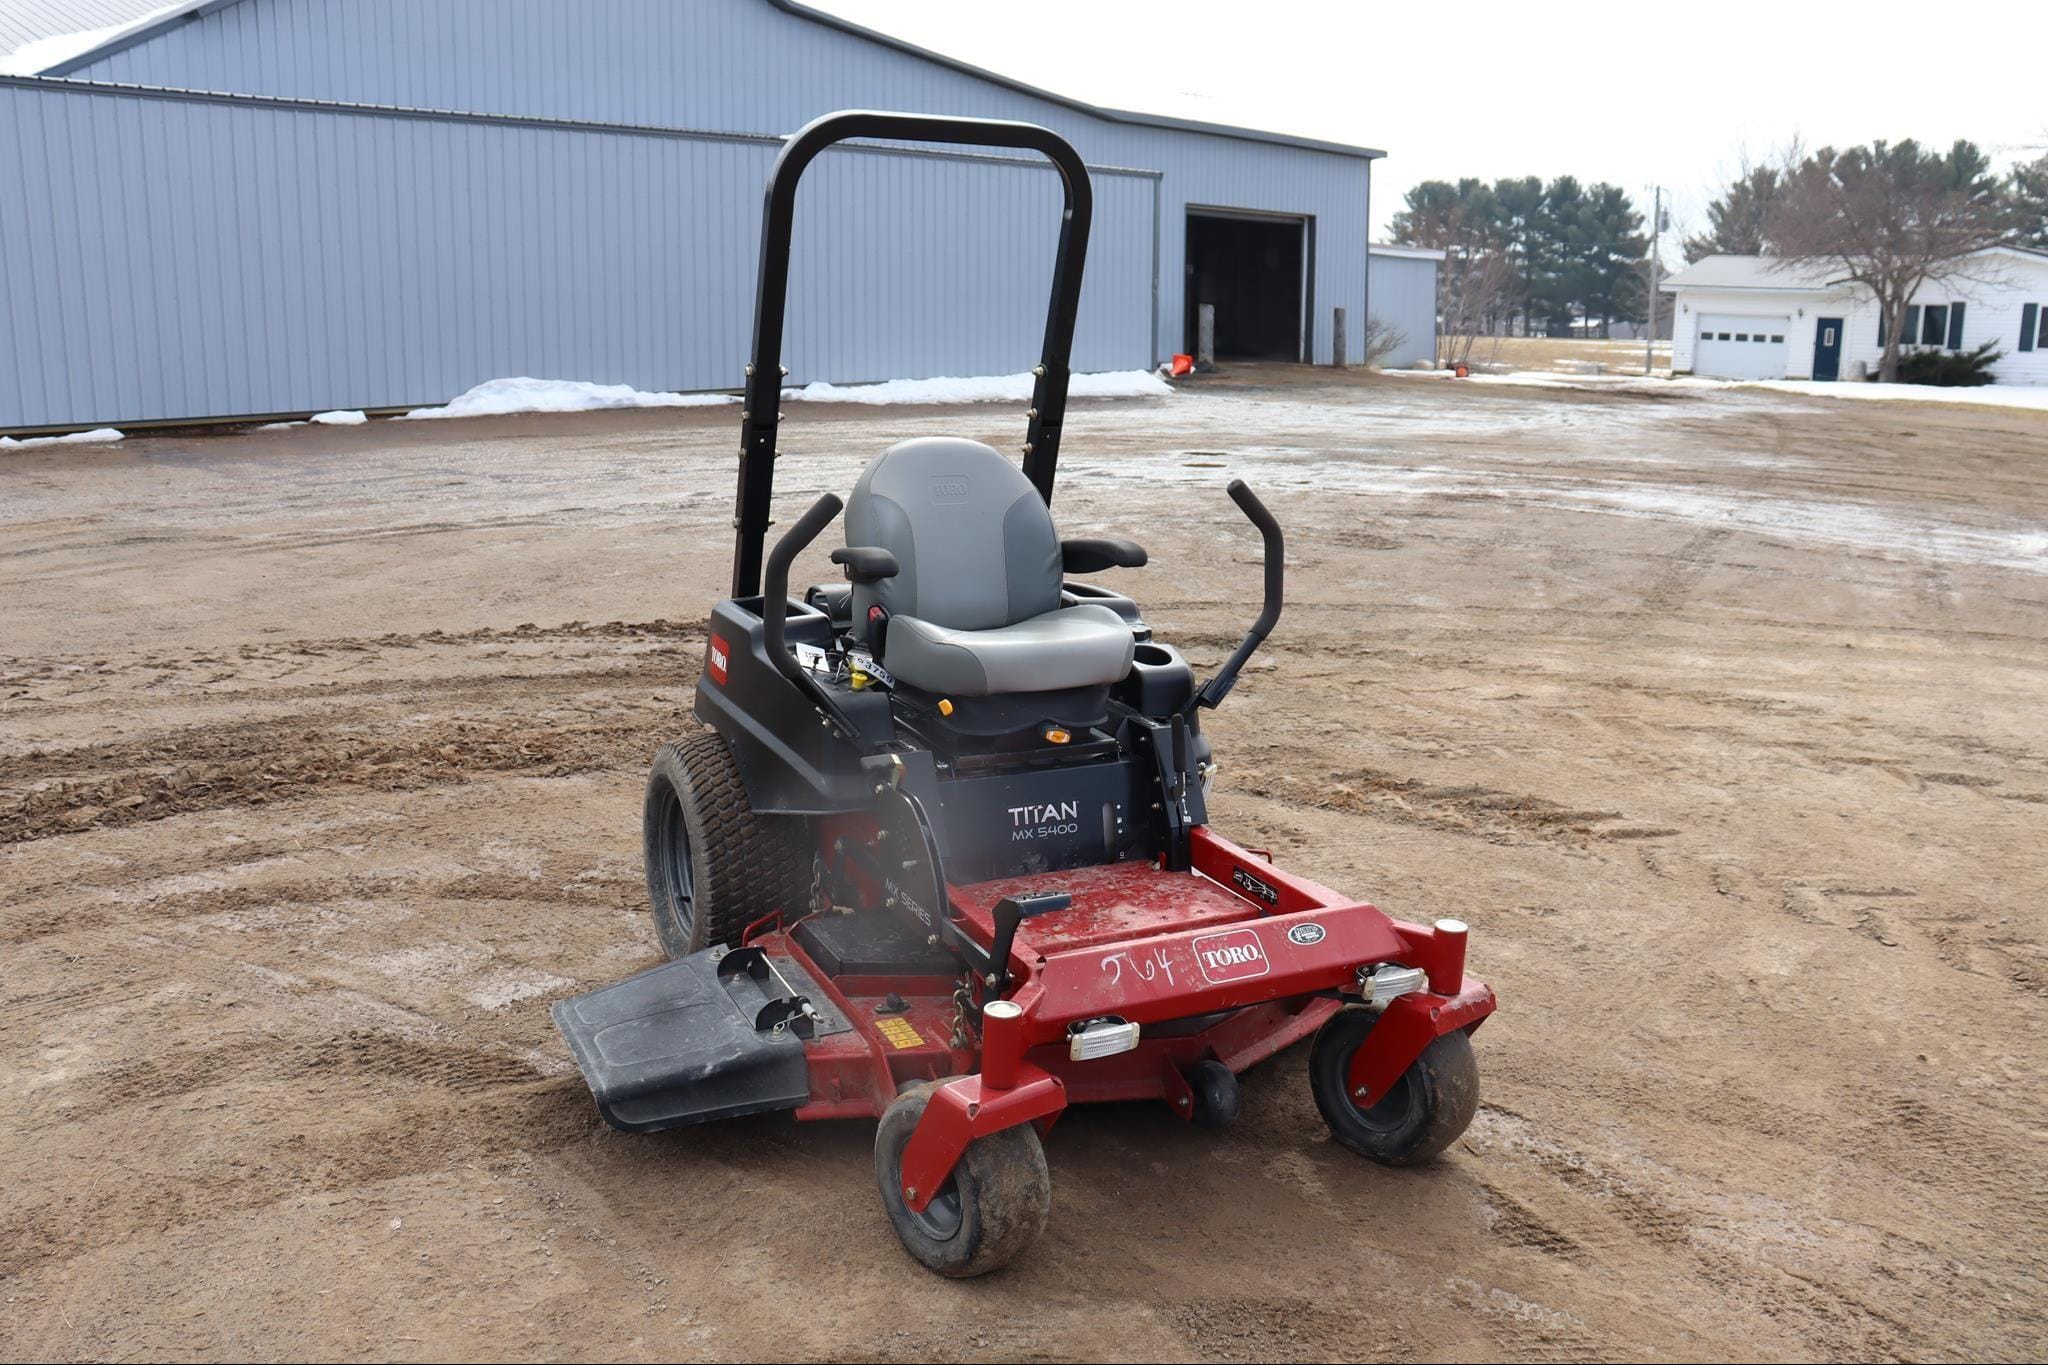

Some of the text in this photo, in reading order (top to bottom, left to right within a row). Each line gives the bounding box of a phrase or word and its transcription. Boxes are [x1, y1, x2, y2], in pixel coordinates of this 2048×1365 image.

[1008, 800, 1078, 826] TITAN
[1012, 823, 1078, 841] MX 5400
[885, 877, 931, 926] MX SERIES
